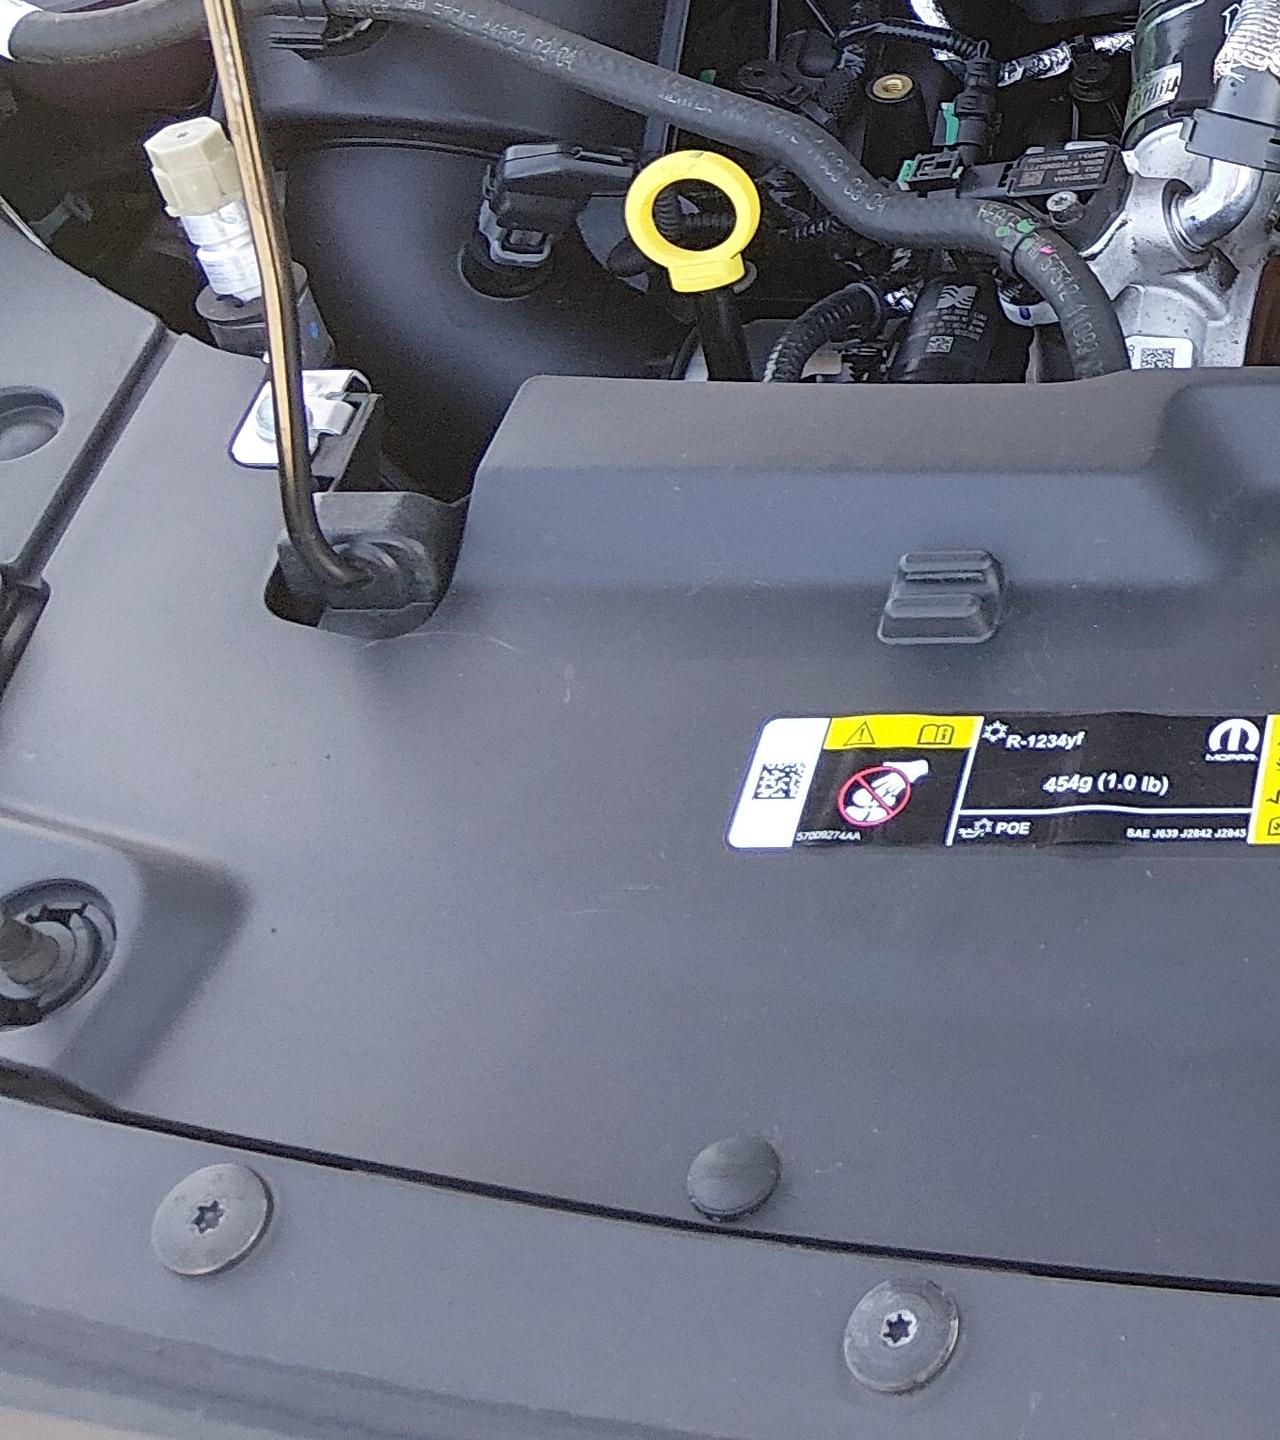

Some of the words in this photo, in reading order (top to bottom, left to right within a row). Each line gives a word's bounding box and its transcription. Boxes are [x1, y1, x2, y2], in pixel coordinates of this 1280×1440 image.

[1005, 732, 1086, 749] R-1234yf
[1205, 753, 1259, 762] MOPAR
[1043, 774, 1093, 793] 454g
[1098, 772, 1134, 792] (1.0
[1140, 774, 1169, 796] lb)
[995, 822, 1032, 835] POE
[1126, 827, 1151, 838] SAE
[1152, 828, 1179, 838] J639
